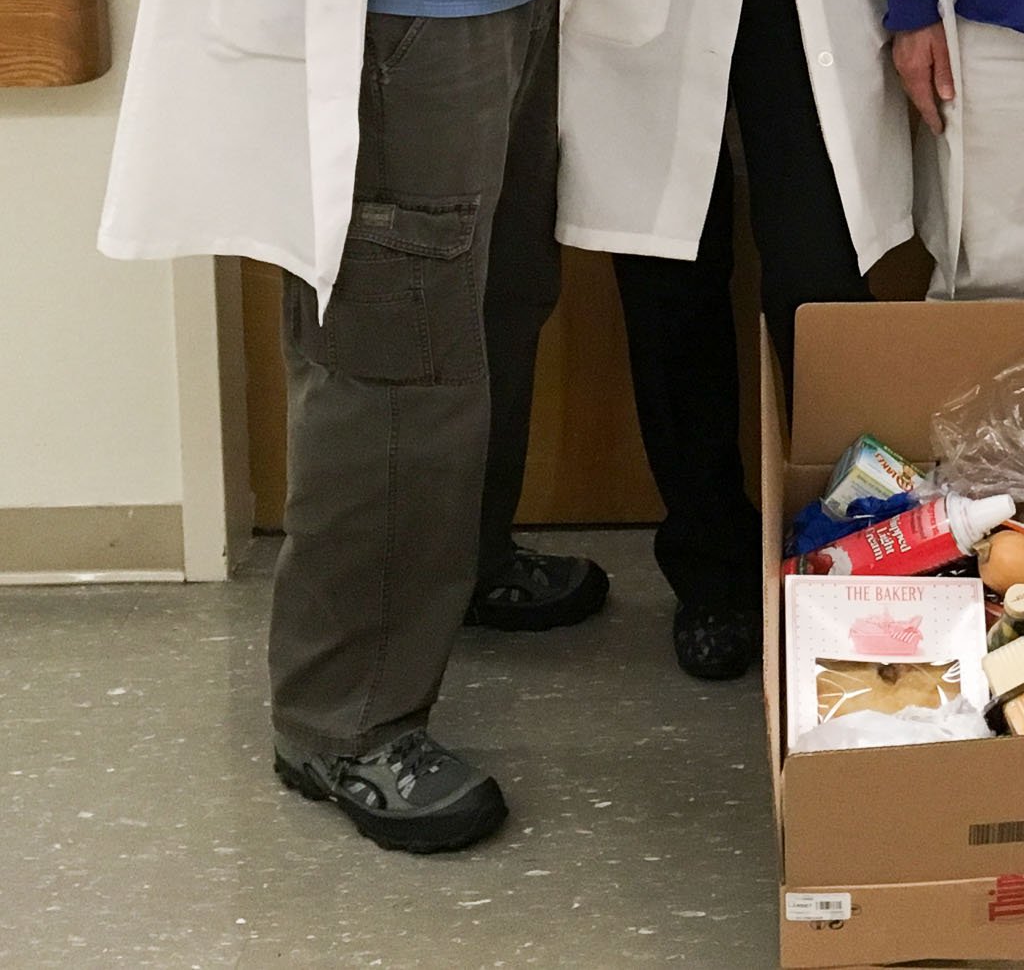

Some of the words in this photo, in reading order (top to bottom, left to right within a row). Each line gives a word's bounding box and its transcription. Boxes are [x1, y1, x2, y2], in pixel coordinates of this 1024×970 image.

[875, 526, 895, 555] Light
[845, 586, 871, 601] THE
[875, 586, 925, 602] BAKERY
